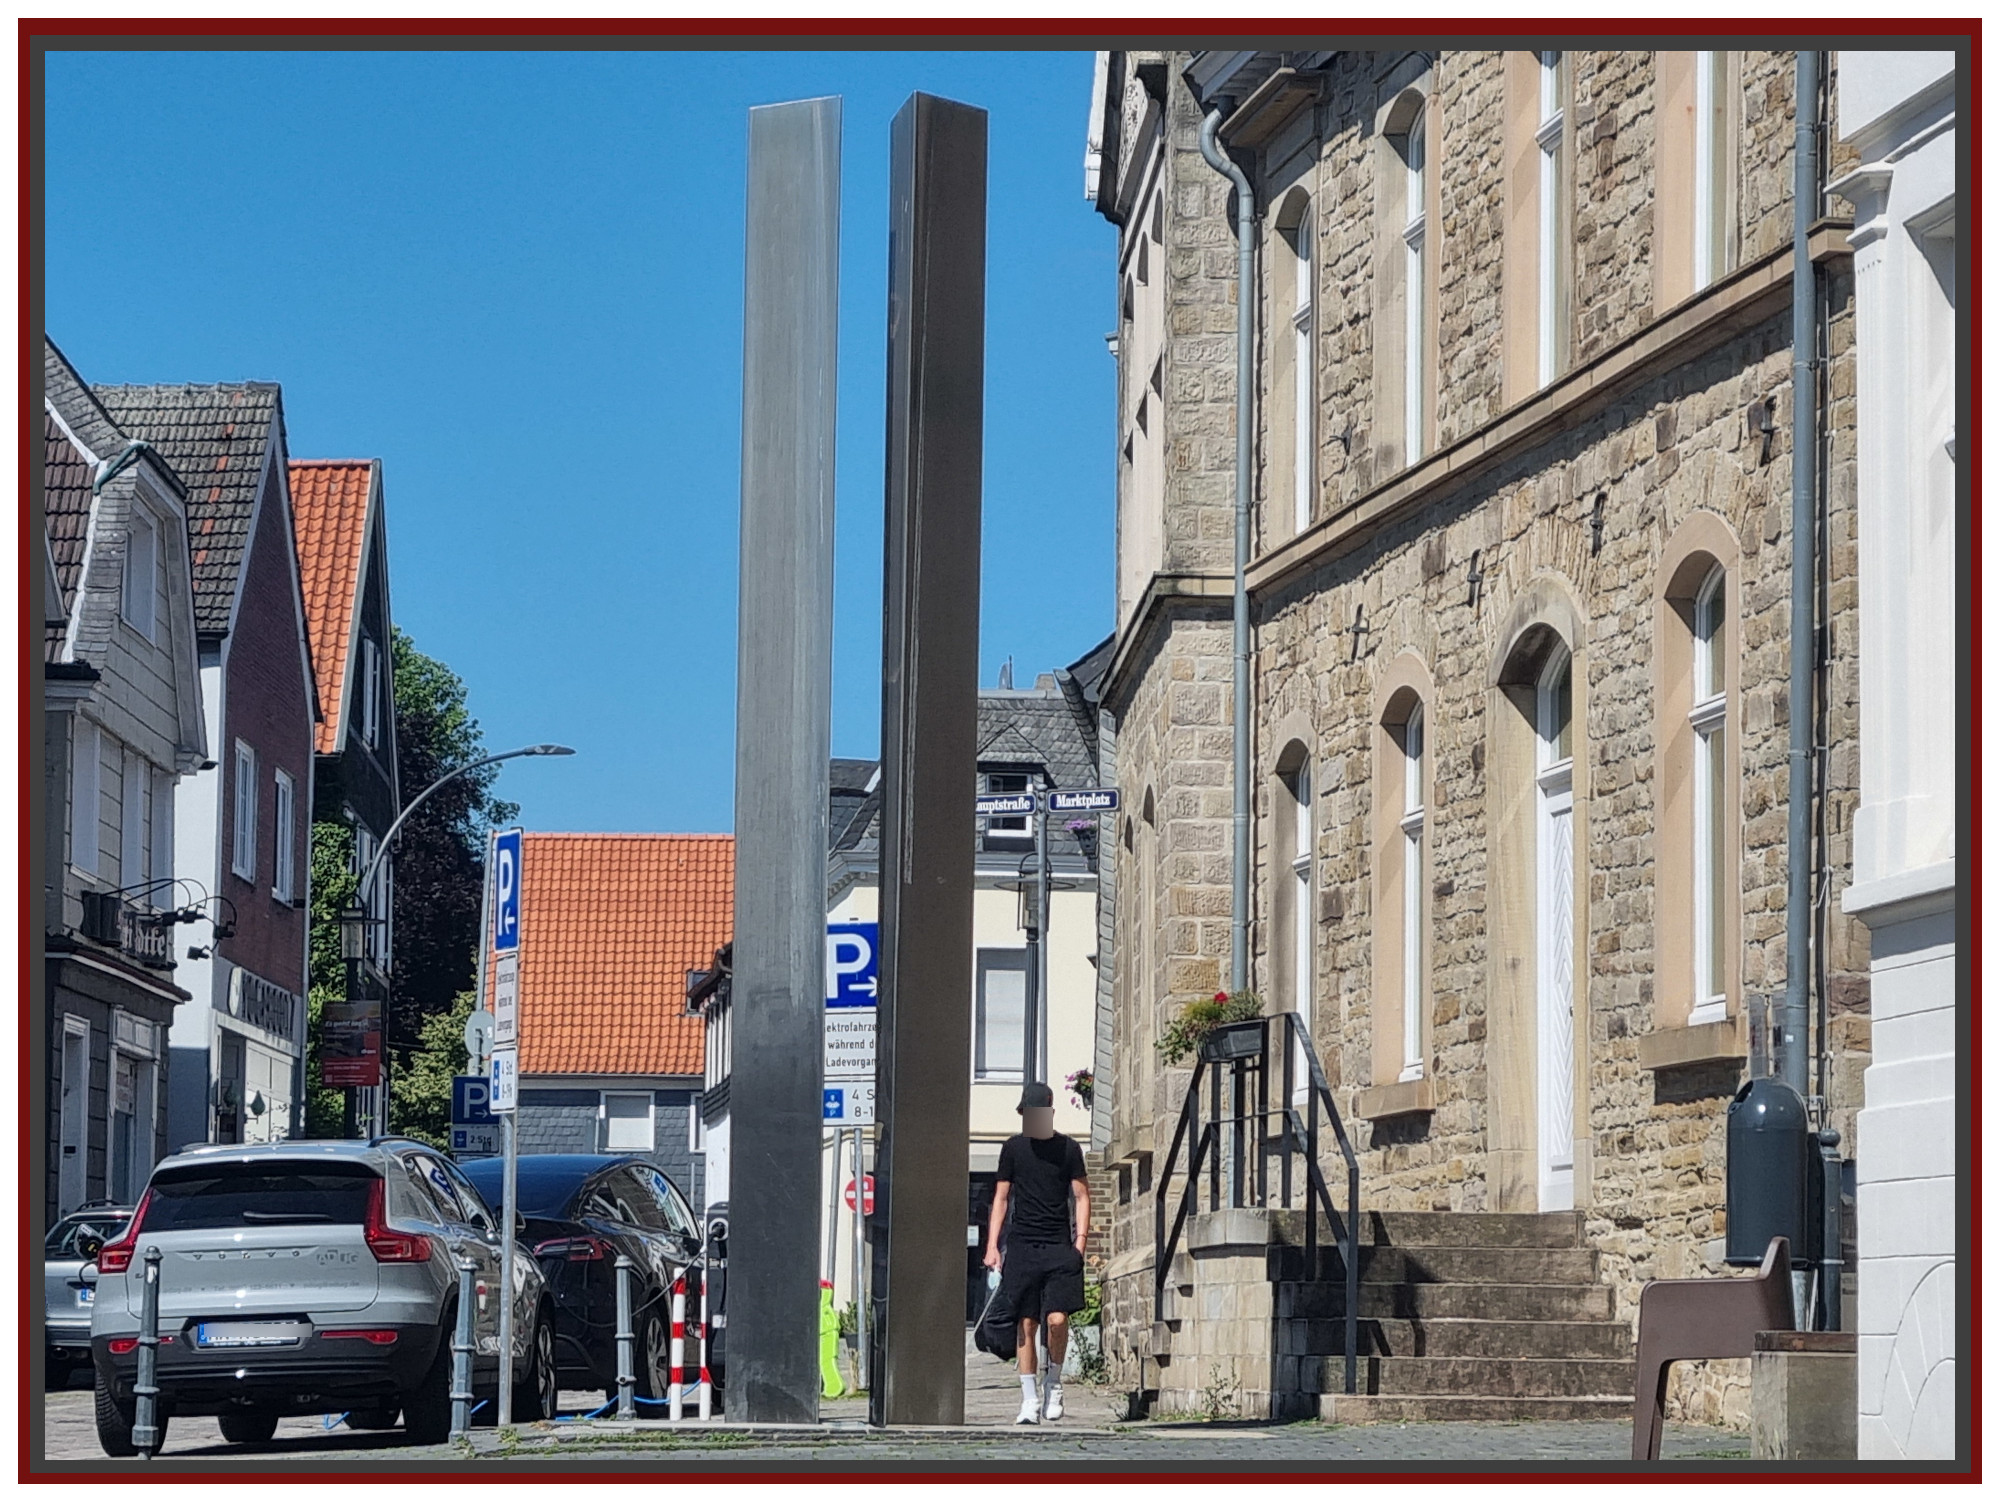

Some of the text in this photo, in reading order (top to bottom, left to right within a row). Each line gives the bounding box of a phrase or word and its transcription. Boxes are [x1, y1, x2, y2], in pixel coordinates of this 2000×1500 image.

[976, 796, 1031, 814] auptstraße
[1056, 793, 1110, 809] Marktplatz
[499, 849, 514, 937] P
[826, 933, 872, 999] P
[826, 1021, 876, 1033] ektrofahrze
[828, 1039, 875, 1050] während d
[826, 1056, 875, 1069] Ladevorgan
[463, 1083, 488, 1119] P
[852, 1089, 875, 1101] 4 S
[854, 1106, 874, 1118] 8-1
